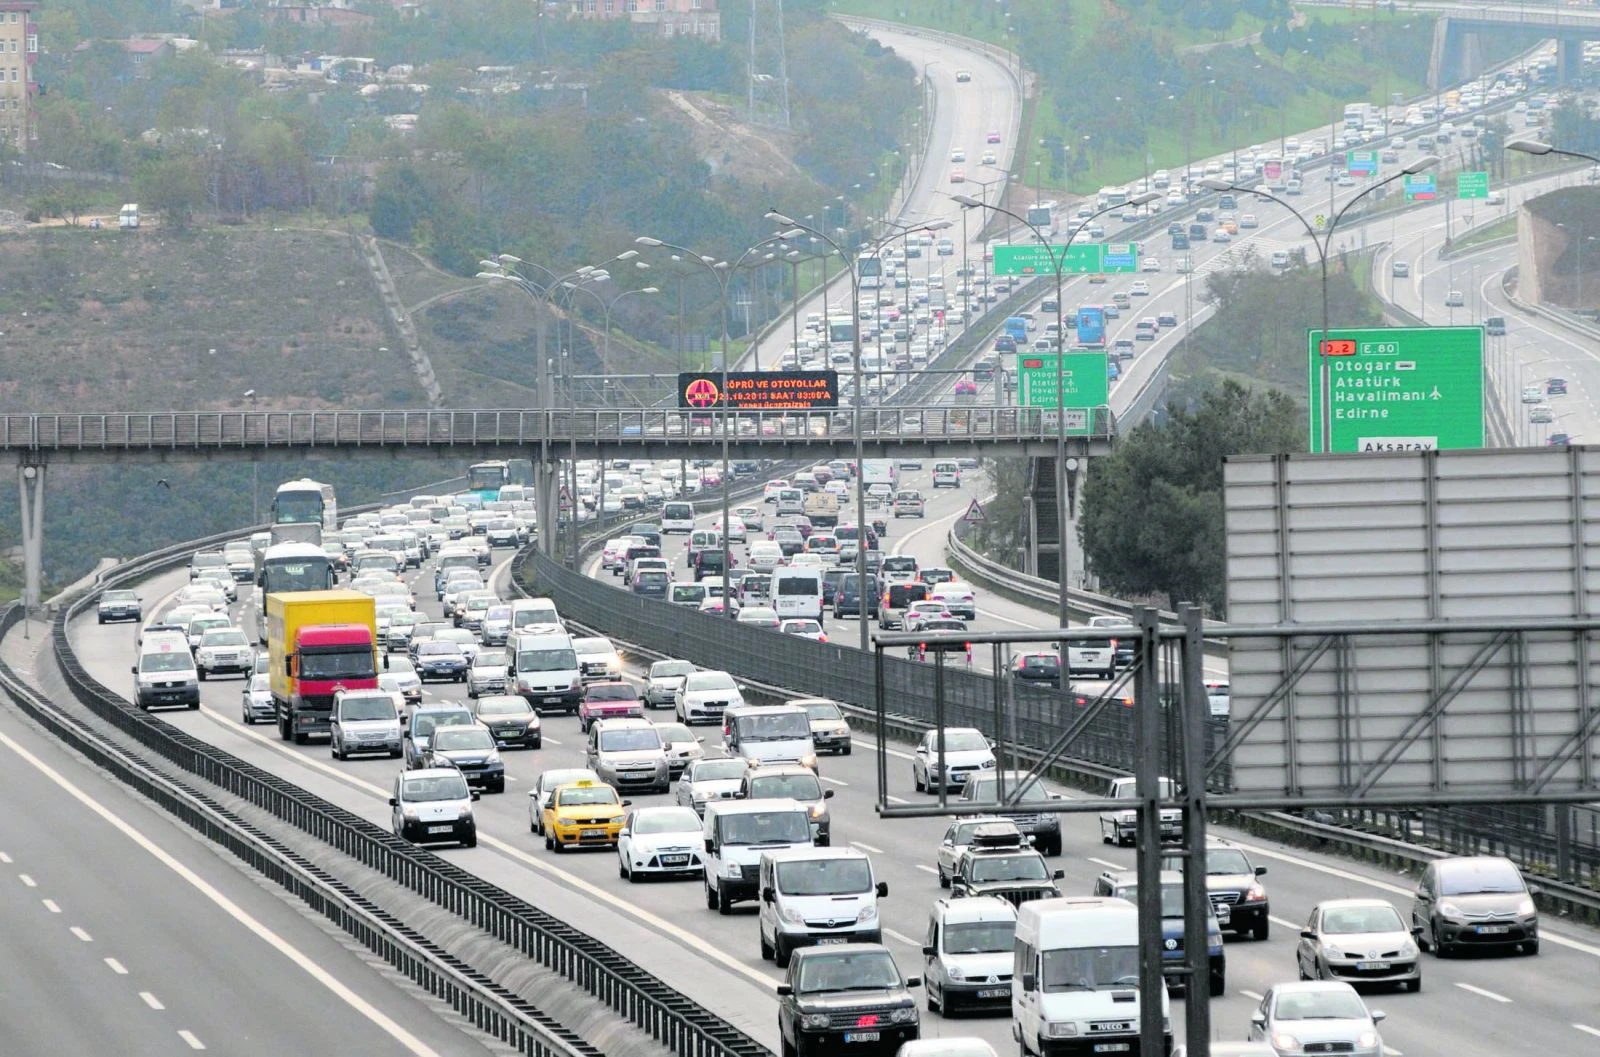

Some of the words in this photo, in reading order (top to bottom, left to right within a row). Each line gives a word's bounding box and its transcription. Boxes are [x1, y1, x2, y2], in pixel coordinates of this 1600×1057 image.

[1335, 361, 1391, 374] Otogar
[756, 380, 769, 388] VE
[771, 379, 827, 389] OTOYOLLAR
[1336, 376, 1401, 387] Atatürk
[770, 391, 795, 400] SAAT
[1335, 391, 1426, 402] Havalimanı
[1335, 408, 1389, 419] Edirne
[1097, 1022, 1124, 1031] IVECO
